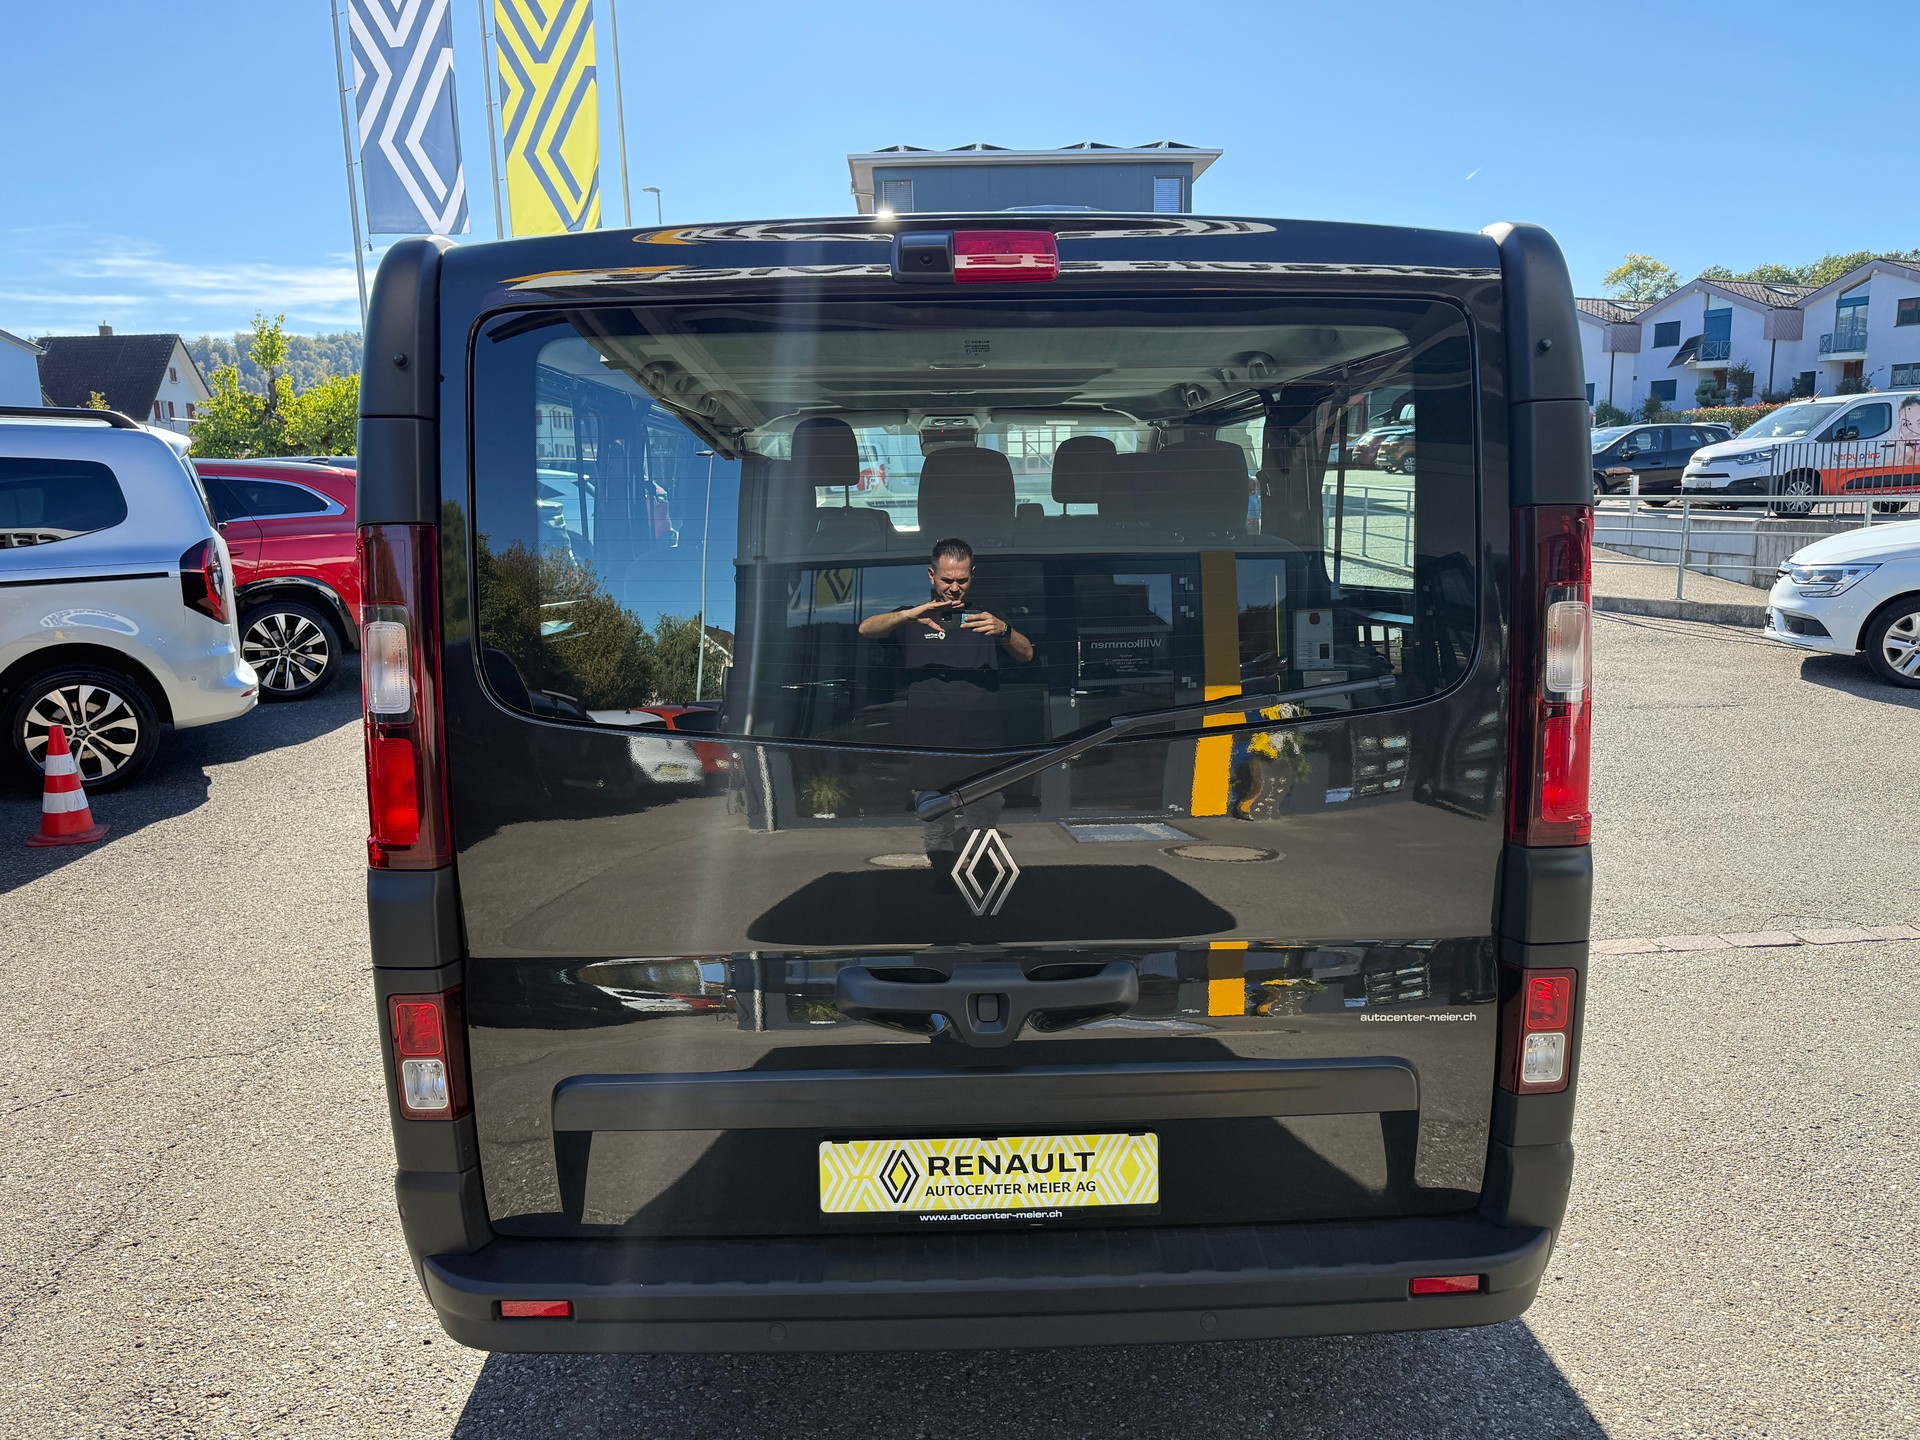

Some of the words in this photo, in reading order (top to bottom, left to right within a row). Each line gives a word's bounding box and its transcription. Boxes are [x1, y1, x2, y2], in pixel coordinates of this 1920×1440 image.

[1360, 1012, 1477, 1022] autocenter-meier.ch
[927, 1152, 1095, 1176] RENAULT
[925, 1184, 1022, 1196] AUTOCENTER
[1028, 1182, 1072, 1194] MEIER
[1076, 1180, 1097, 1193] AG
[919, 1209, 1063, 1222] www.autocenter-meier.ch
